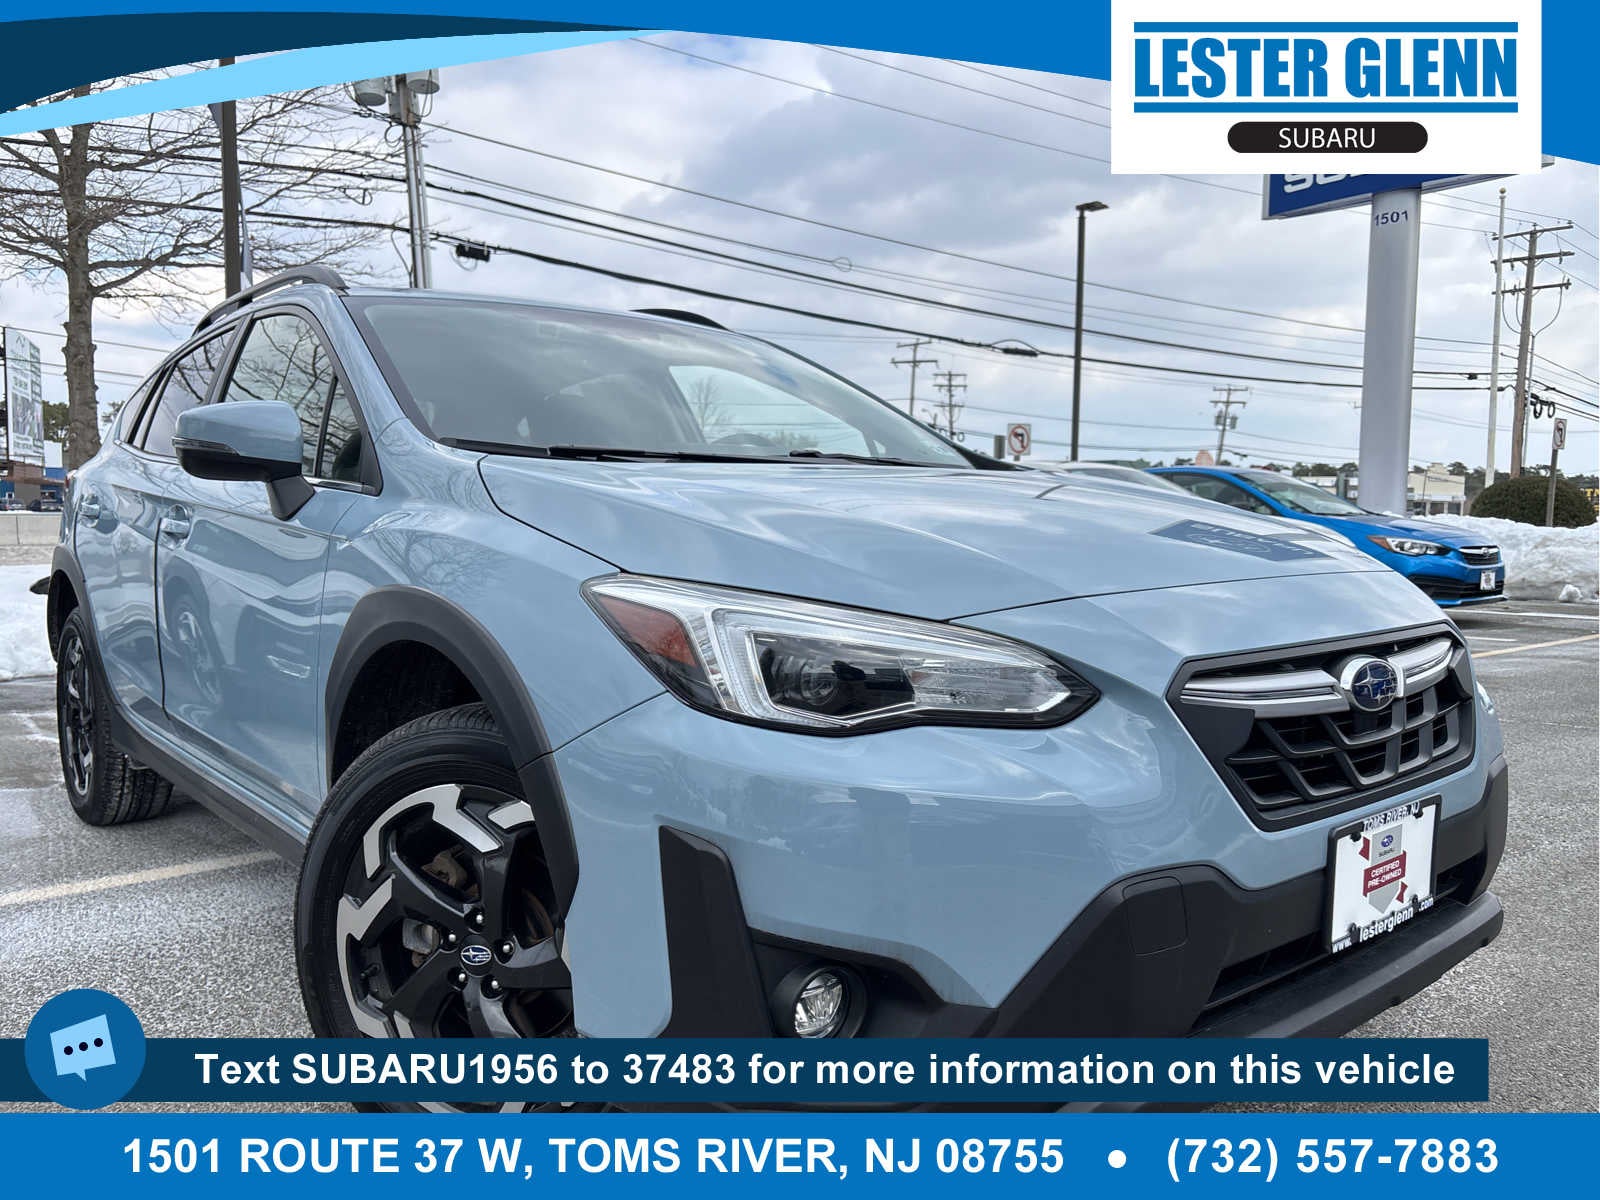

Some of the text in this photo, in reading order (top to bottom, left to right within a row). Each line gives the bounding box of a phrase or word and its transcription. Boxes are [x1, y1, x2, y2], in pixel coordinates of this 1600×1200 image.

[1374, 209, 1409, 227] 1501
[1367, 868, 1402, 889] PRE-OWNED
[1370, 860, 1400, 878] CERTIFIED
[1359, 907, 1414, 943] lesterglenn
